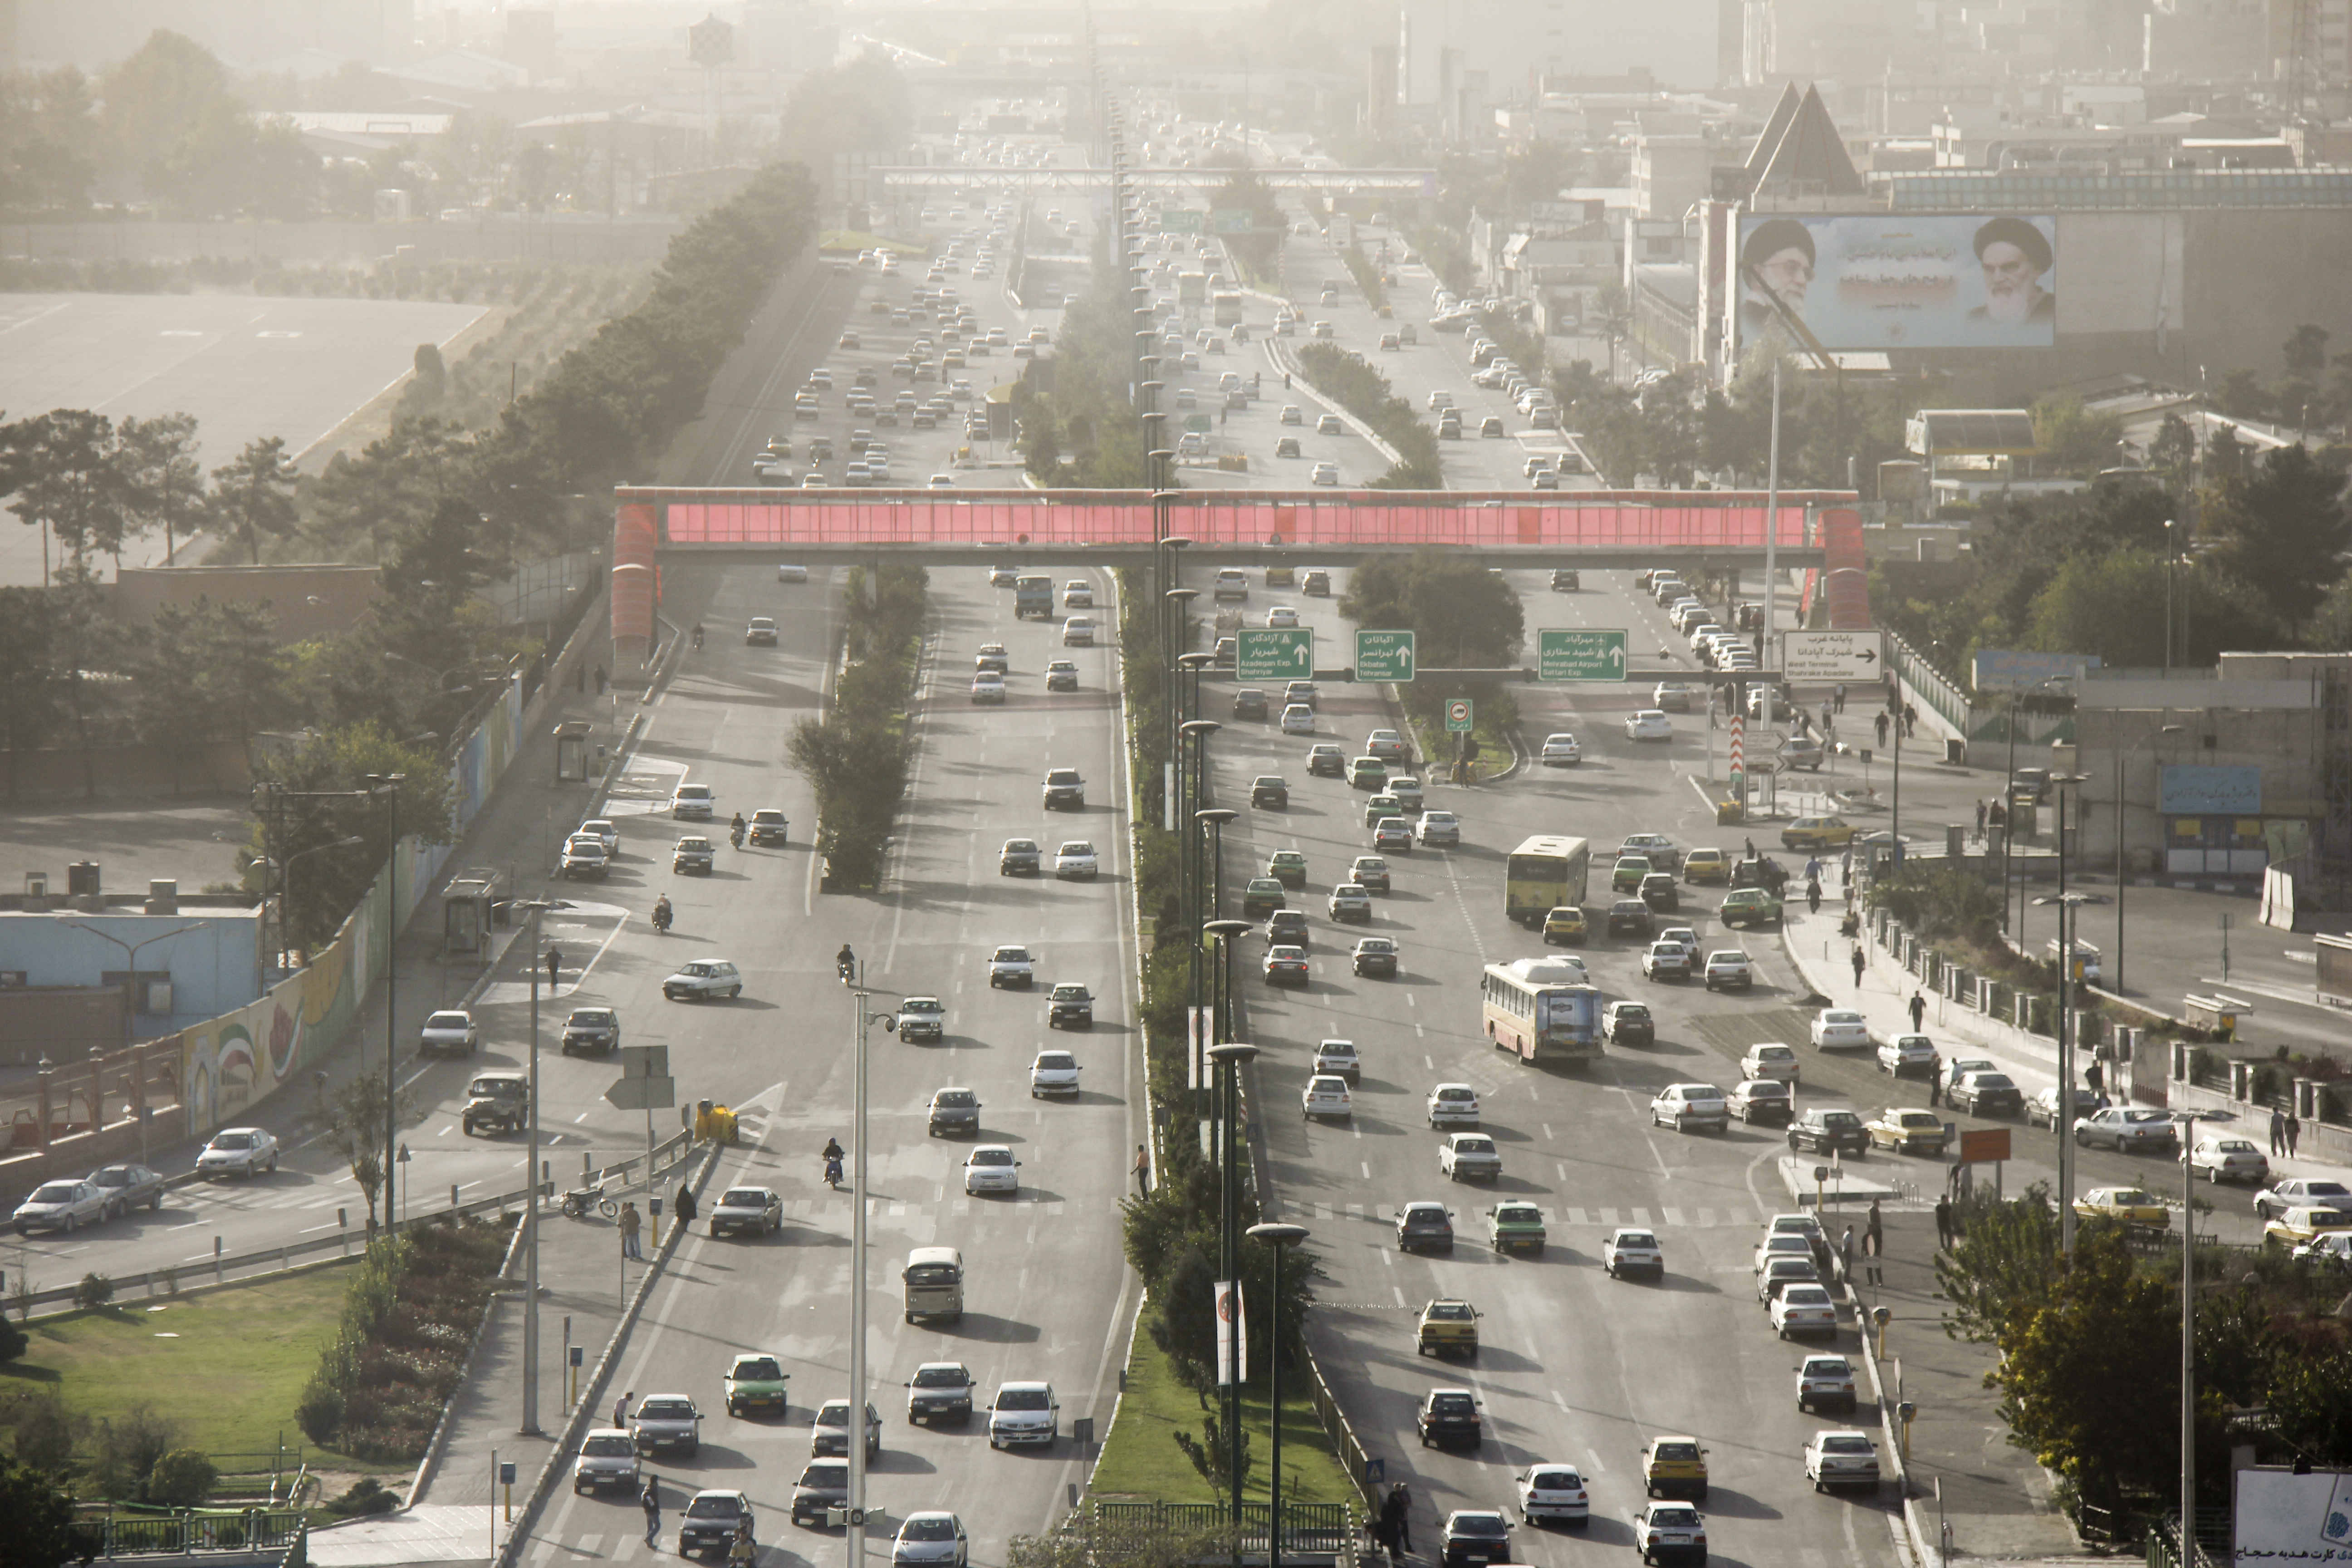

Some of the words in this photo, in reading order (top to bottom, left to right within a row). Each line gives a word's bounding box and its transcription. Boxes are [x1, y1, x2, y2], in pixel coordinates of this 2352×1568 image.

[1248, 633, 1279, 644] آزادگان
[1365, 636, 1393, 645] اکباتان
[1565, 635, 1594, 645] مهرآباد
[1808, 635, 1828, 644] غرب
[1829, 635, 1853, 645] پایانه
[1250, 647, 1279, 658] شهریار
[1361, 649, 1393, 658] تهرانسر
[1543, 647, 1570, 657] ستاری
[1572, 647, 1594, 657] شهید
[1798, 647, 1825, 659] آپادانا
[1826, 647, 1853, 657] شهرک
[2236, 1546, 2276, 1560] حجاج
[2278, 1549, 2308, 1561] هدیه
[2311, 1548, 2336, 1562] کارت
